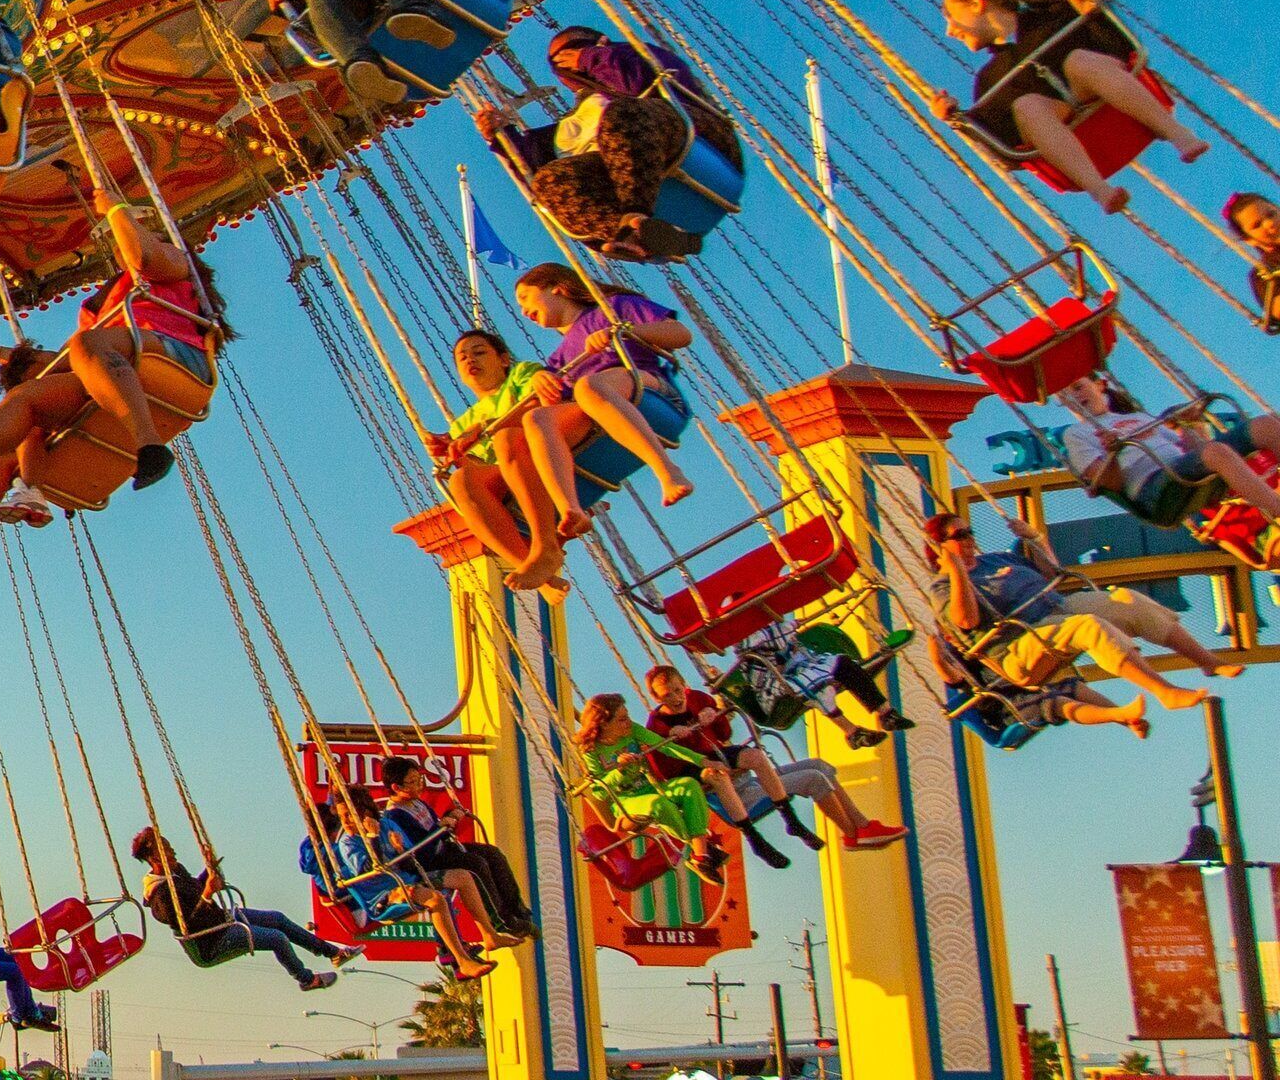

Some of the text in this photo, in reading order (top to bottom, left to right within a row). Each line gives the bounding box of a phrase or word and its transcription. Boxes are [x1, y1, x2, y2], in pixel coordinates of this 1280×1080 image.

[314, 752, 464, 789] RIDS!
[645, 930, 696, 944] GAMES
[1131, 945, 1206, 957] PLEASURE
